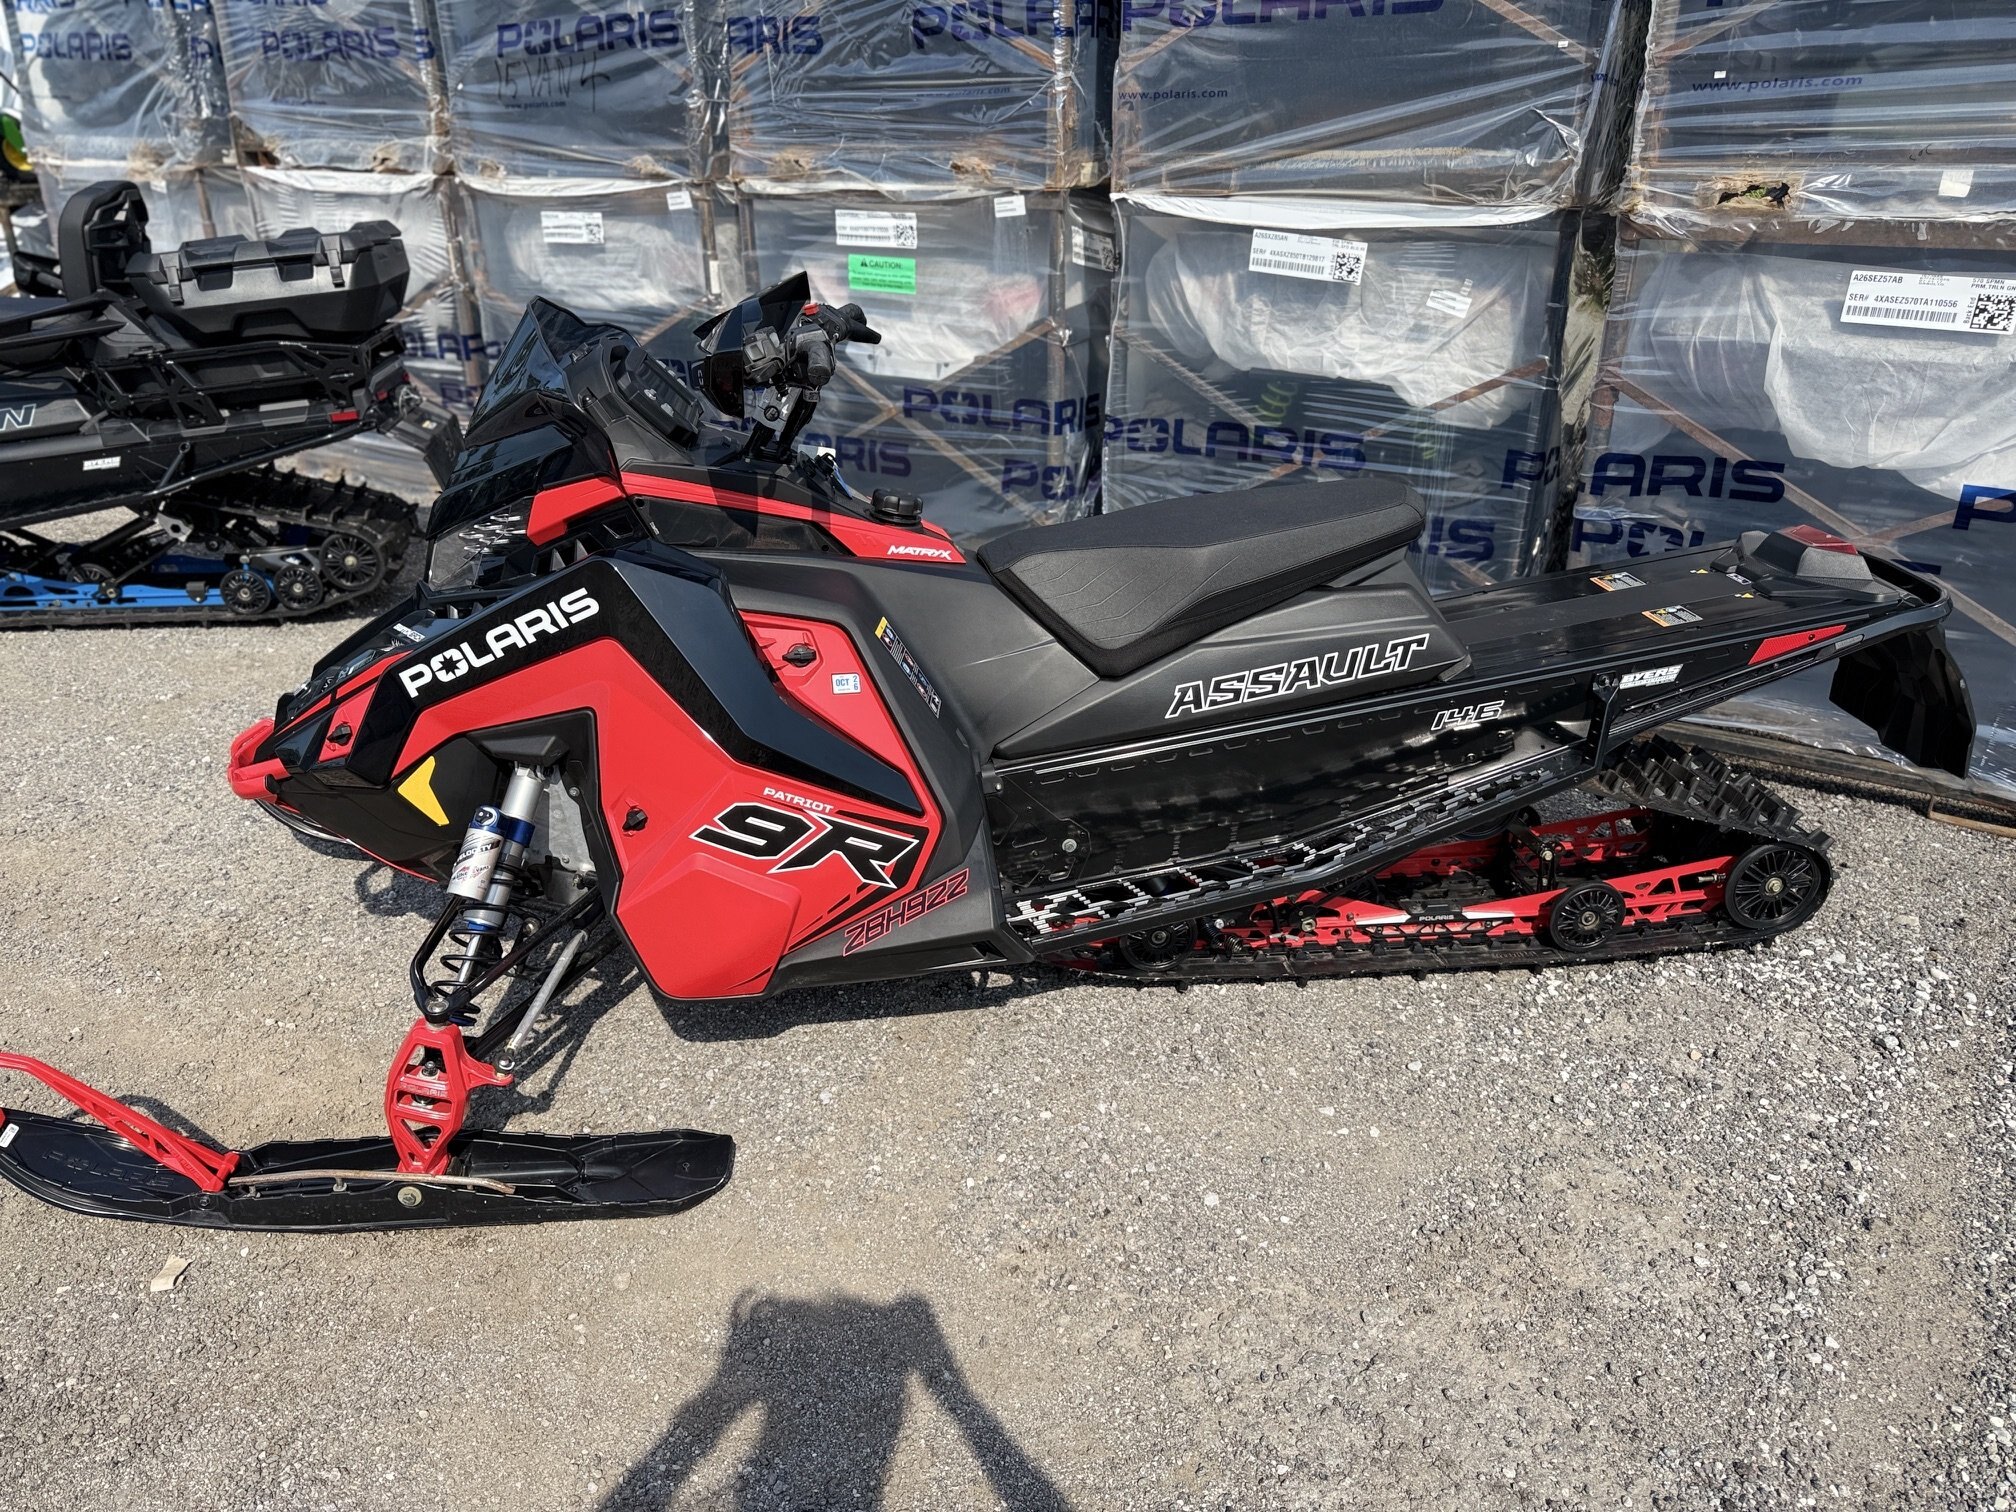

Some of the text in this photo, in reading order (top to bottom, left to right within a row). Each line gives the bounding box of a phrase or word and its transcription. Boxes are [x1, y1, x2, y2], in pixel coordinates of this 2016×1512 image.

[20, 32, 132, 61] POLARIS
[261, 26, 401, 61] POLARIS
[497, 9, 680, 57] POLARIS
[1118, 88, 1228, 101] www.polaris.com
[1692, 74, 1863, 92] www.polaris.com
[1853, 273, 1904, 284] A26SEZ57AB
[1848, 293, 1870, 302] SER#
[904, 385, 1100, 436] POLARIS
[1103, 414, 1366, 472] POLARIS
[886, 544, 952, 561] MATRYX
[398, 586, 600, 699] POLARIS
[835, 678, 850, 687] OCT
[1164, 633, 1430, 719] ASSAULT
[1622, 664, 1683, 683] BYERS
[1430, 699, 1505, 731] 146
[762, 786, 835, 814] PATRIOT
[688, 801, 920, 889] 9R
[1418, 914, 1455, 922] POLARIS
